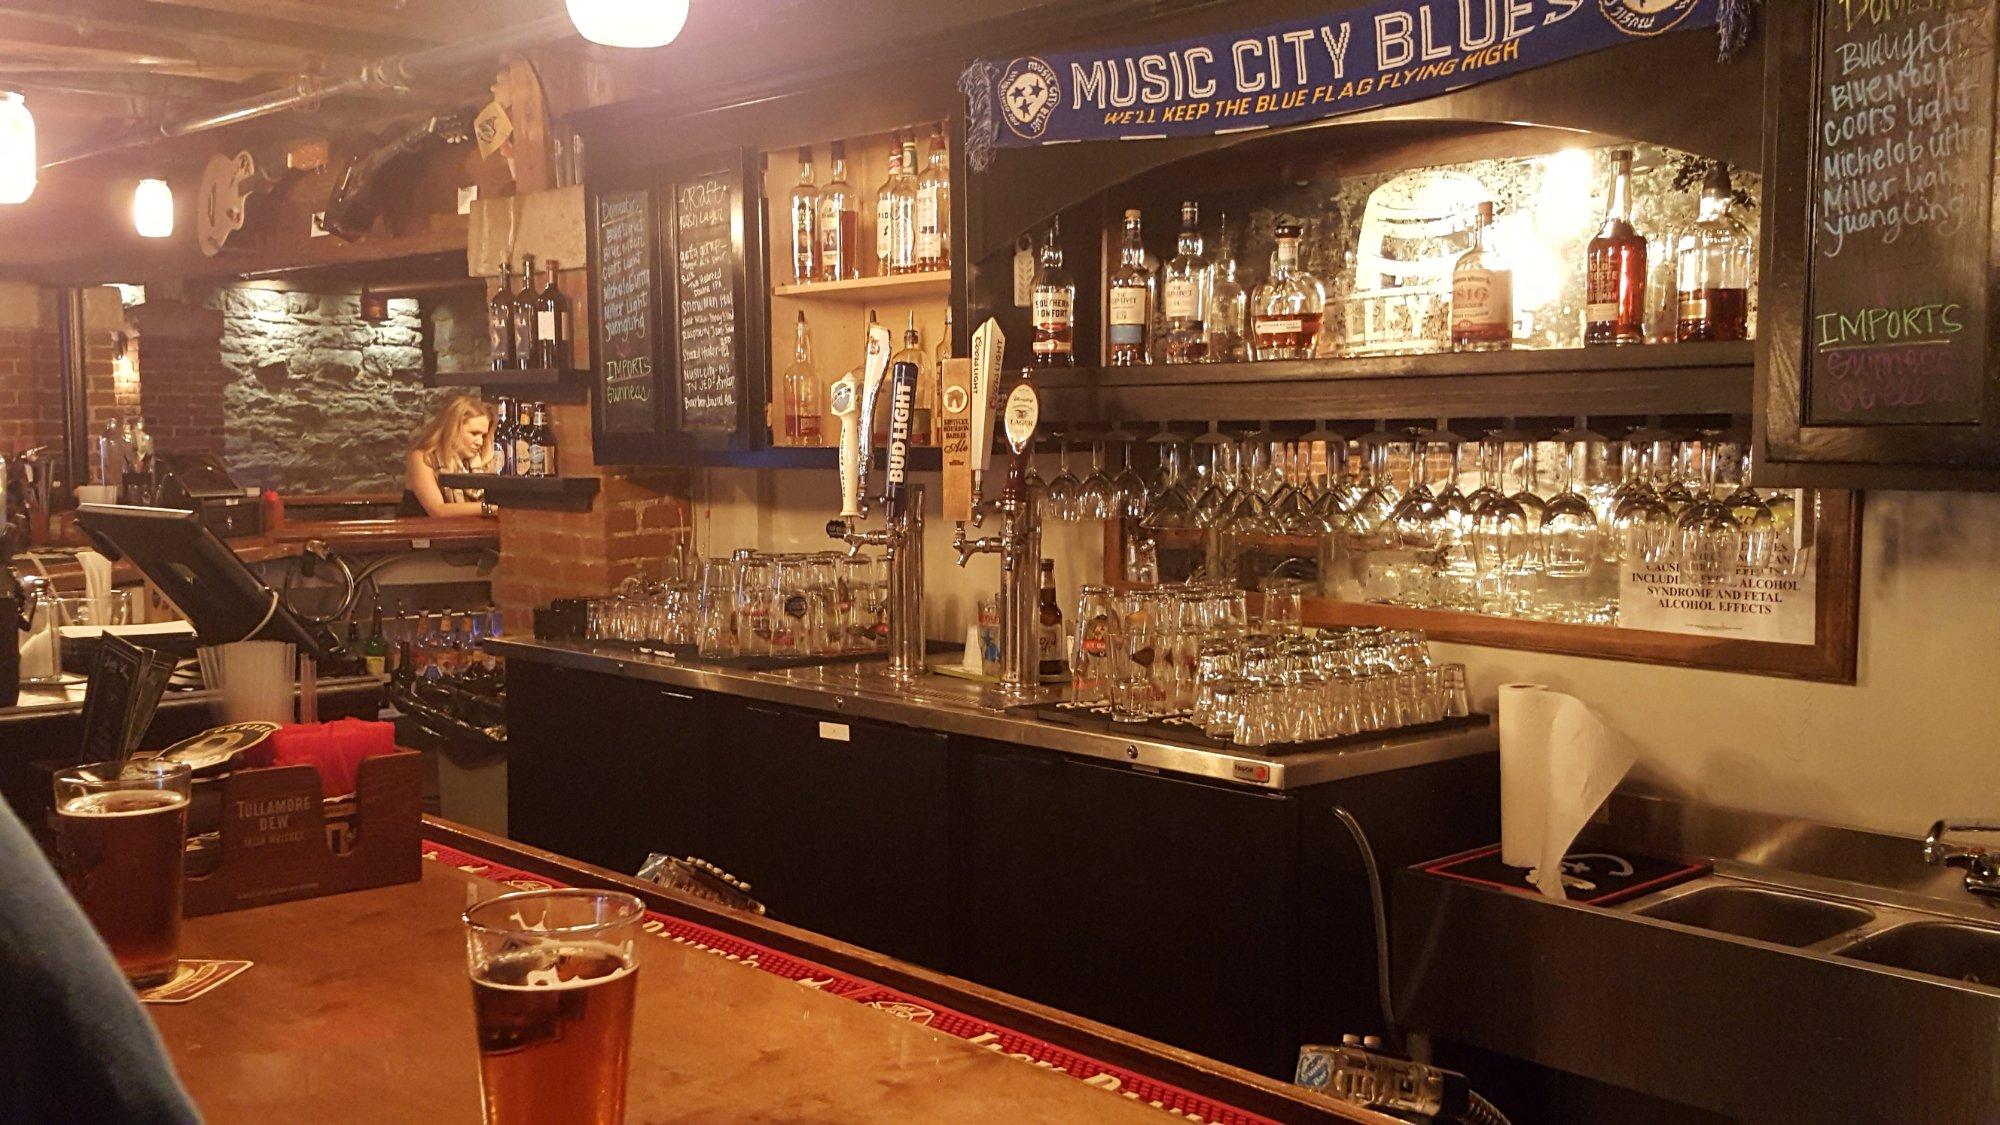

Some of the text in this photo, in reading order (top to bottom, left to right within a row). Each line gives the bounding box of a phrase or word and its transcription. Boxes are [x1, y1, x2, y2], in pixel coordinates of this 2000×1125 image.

[1028, 61, 1055, 85] MUSIC
[1071, 47, 1216, 110] MUSIC
[1232, 22, 1350, 93] CITY
[1104, 38, 1520, 125] WE'LL KEEP THE BLUE FLAG FLYING HIGH
[1824, 103, 1897, 147] Coors
[1824, 131, 1924, 183] Michelob
[1824, 176, 1897, 217] Miller
[1816, 303, 1963, 347] IMPORTS
[606, 356, 651, 382] IMPORTS
[889, 382, 912, 484] BUD LIGHT
[944, 438, 968, 454] Ale
[1647, 585, 1783, 603] SYNDROME AND FETAL
[1739, 579, 1801, 592] ALCOHOL
[1657, 598, 1772, 615] ALCOHOL EFFECTS
[236, 796, 311, 819] TULLAMORE
